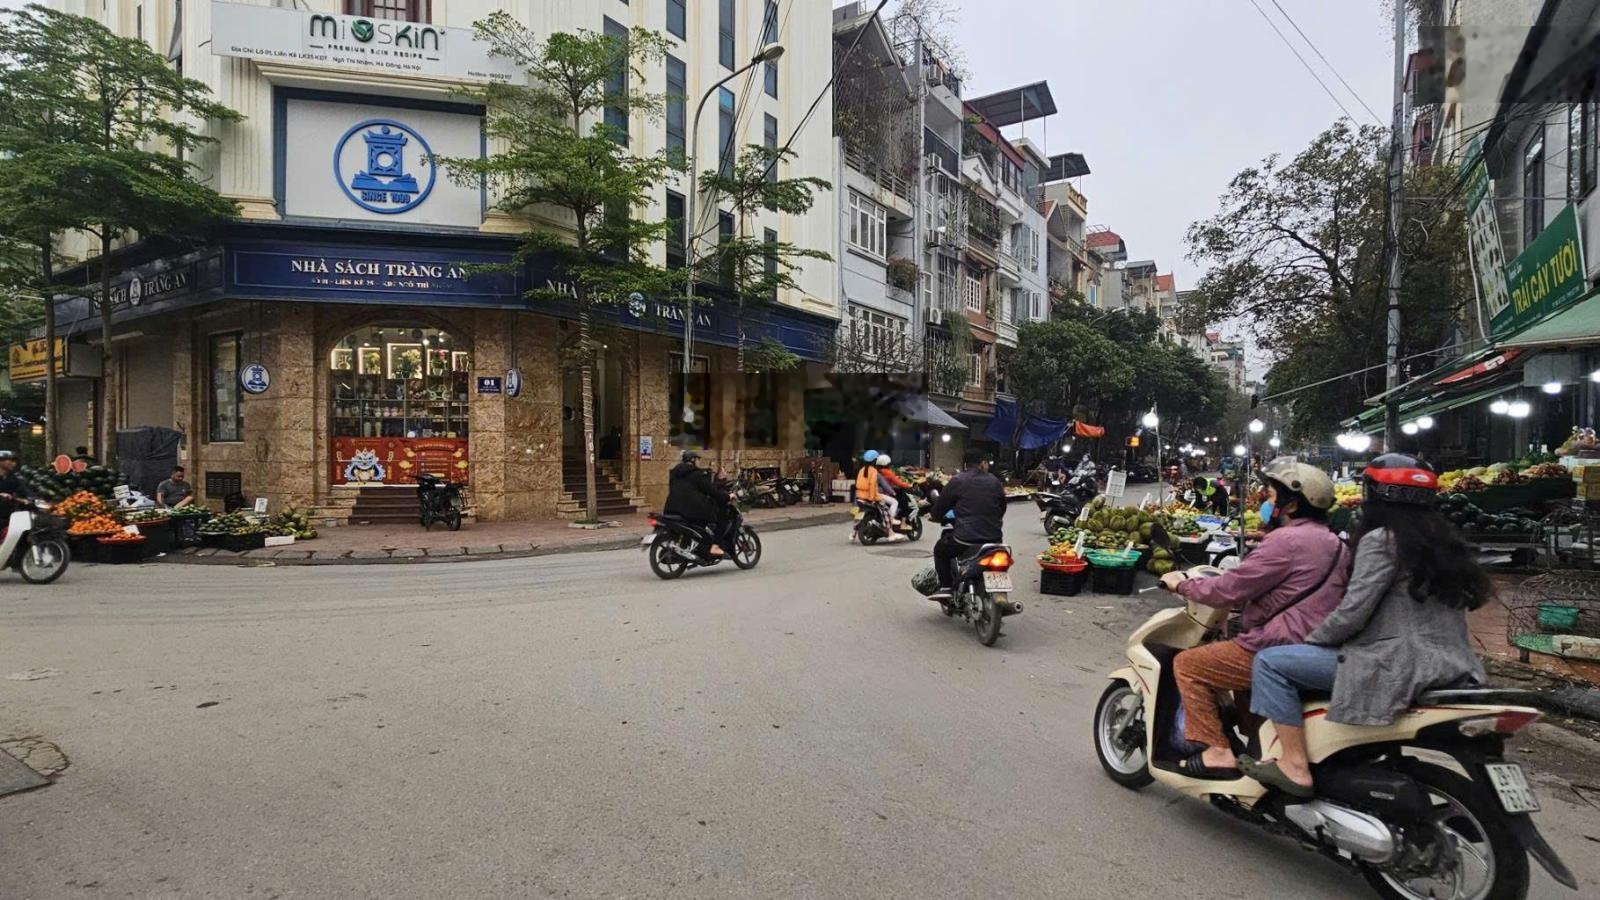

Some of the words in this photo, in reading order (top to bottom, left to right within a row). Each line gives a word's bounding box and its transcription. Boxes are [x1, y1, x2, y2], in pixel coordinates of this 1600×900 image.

[327, 43, 366, 53] PREMIUM
[361, 191, 387, 203] SINCE
[291, 257, 330, 273] NHÀ
[335, 259, 380, 276] SÁCH
[385, 261, 442, 279] TRÀNG
[1512, 276, 1531, 315] TRÁI
[1530, 262, 1550, 303] CÂY
[1550, 238, 1578, 288] TƯƠI
[546, 279, 578, 300] NHÀ
[696, 312, 711, 327] AN
